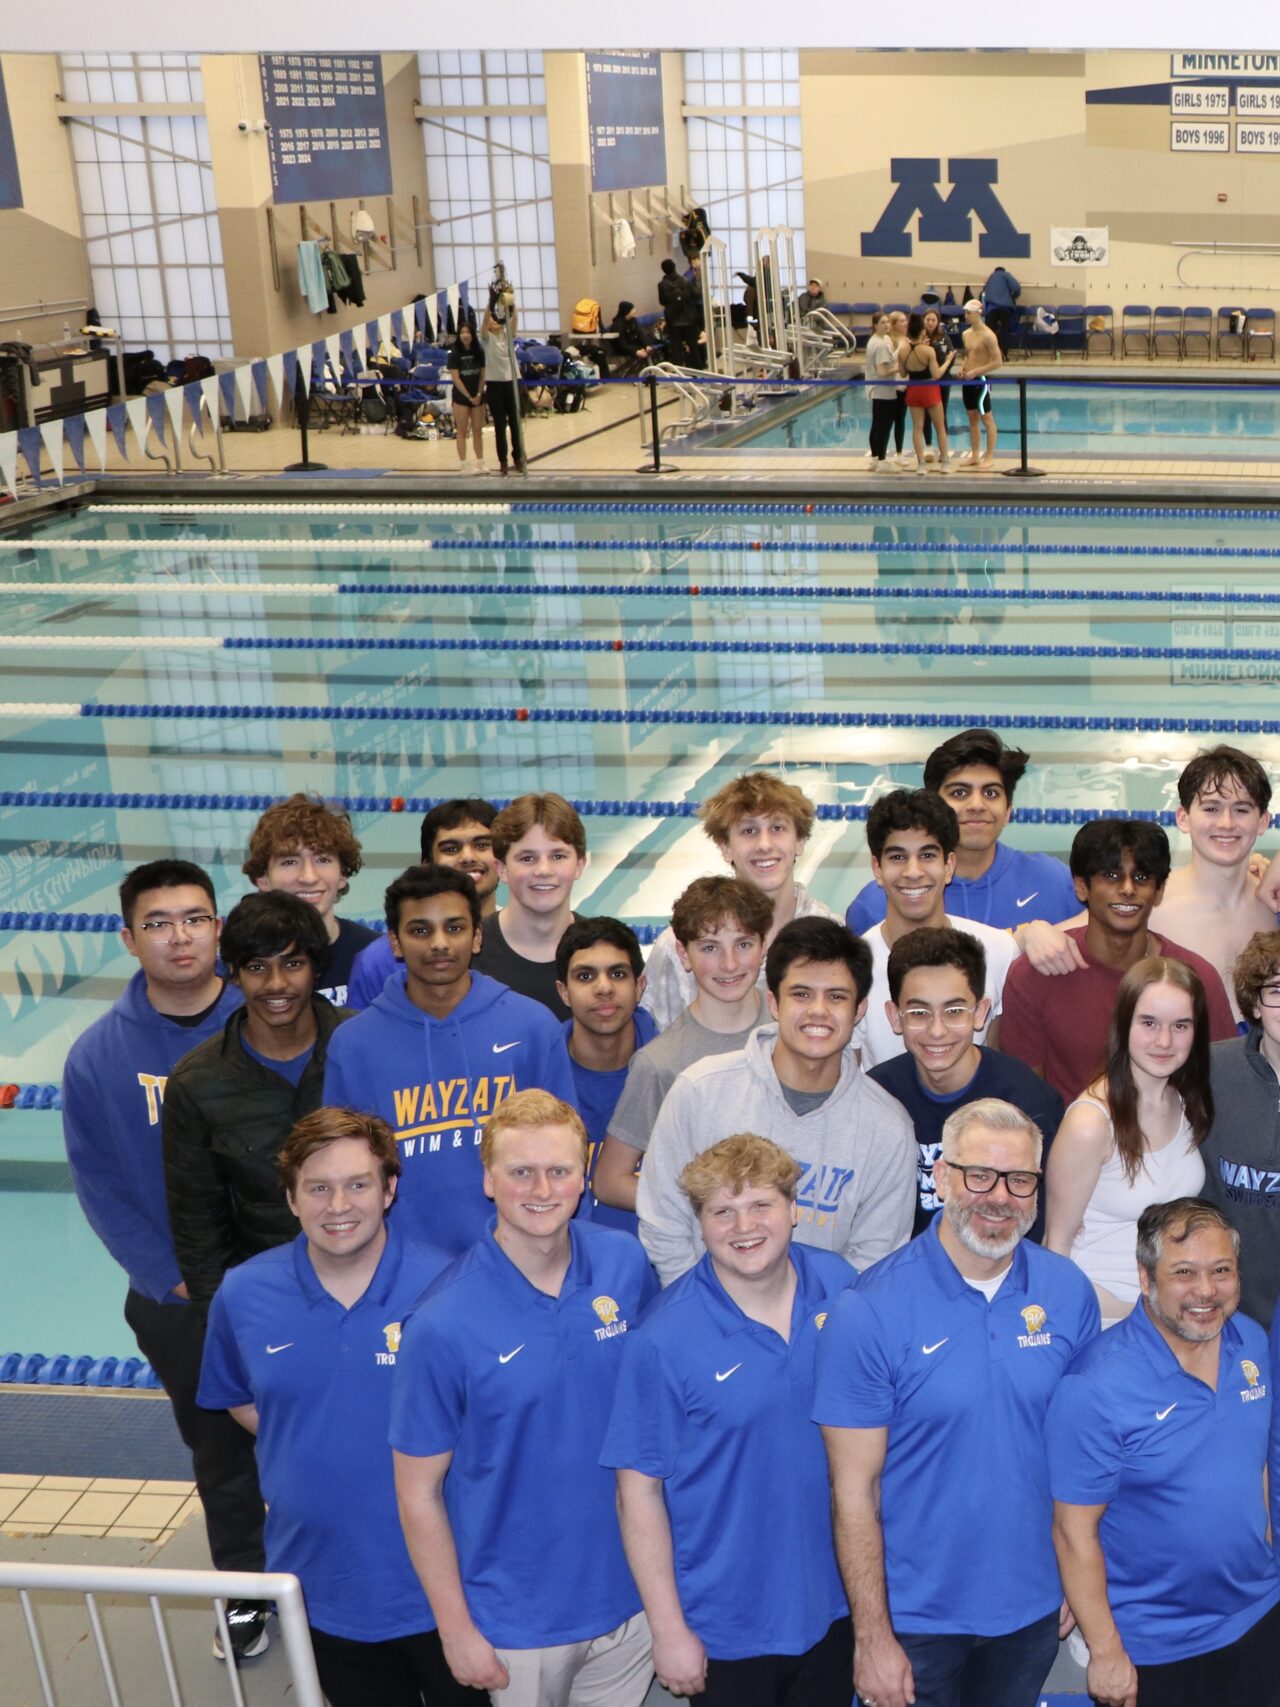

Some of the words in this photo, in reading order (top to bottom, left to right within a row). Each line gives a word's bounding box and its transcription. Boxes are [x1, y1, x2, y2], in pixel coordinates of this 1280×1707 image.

[1174, 93, 1202, 108] GIRLS
[1204, 94, 1227, 108] 1975
[1239, 94, 1267, 109] GIRLS
[1176, 129, 1200, 144] BOYS
[1203, 130, 1225, 145] 1996
[1241, 131, 1265, 146] BOYS
[861, 158, 1031, 258] M
[453, 1129, 463, 1147] &
[594, 1320, 629, 1341] TROJANS
[1017, 1333, 1052, 1348] TROJANS
[1240, 1386, 1266, 1404] TROJANS
